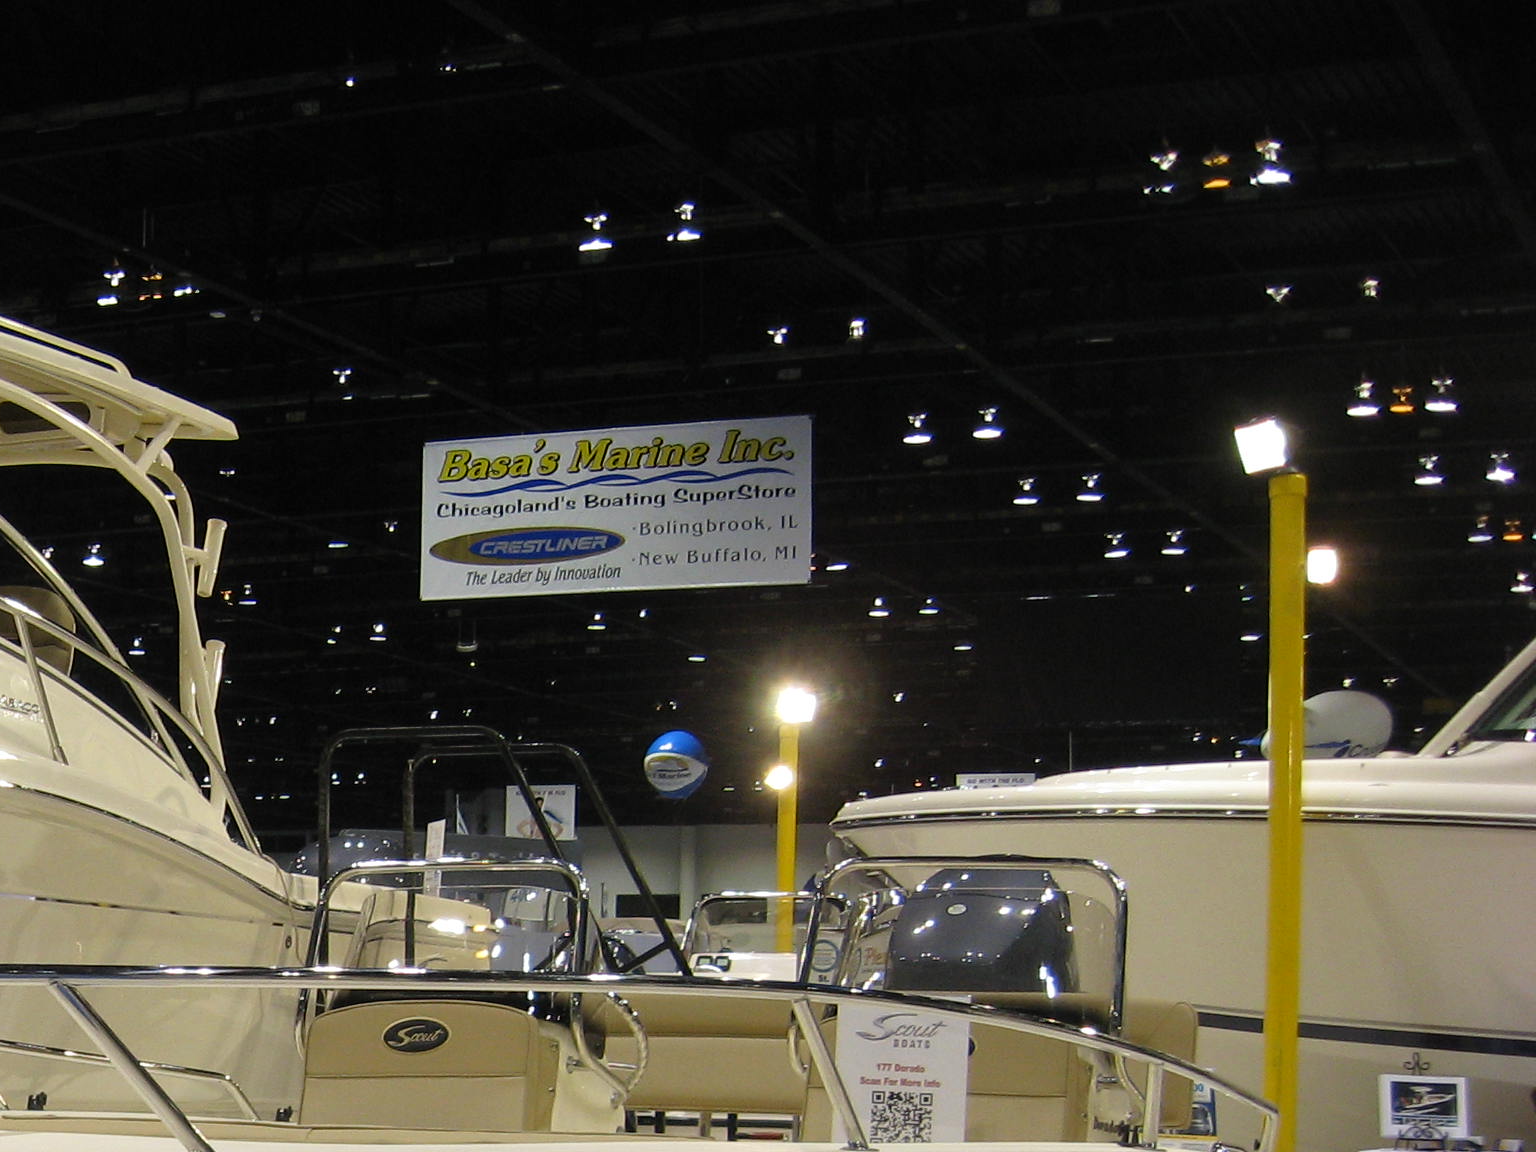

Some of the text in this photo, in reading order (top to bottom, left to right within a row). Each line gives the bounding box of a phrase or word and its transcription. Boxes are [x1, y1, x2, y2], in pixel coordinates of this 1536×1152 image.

[437, 429, 795, 483] Basa's Marine Inc.
[436, 484, 796, 518] Chicagoland's Boating SuperStore
[639, 514, 798, 537] Bolingbrook, IL
[479, 535, 608, 555] CRESTLINER
[638, 545, 797, 565] New Buffalo, MI
[465, 564, 621, 587] The Leader by Innovation
[387, 1025, 445, 1047] Scout
[856, 1013, 948, 1041] Scout
[877, 1063, 926, 1073] 177 Dorado
[859, 1076, 882, 1086] Scan
